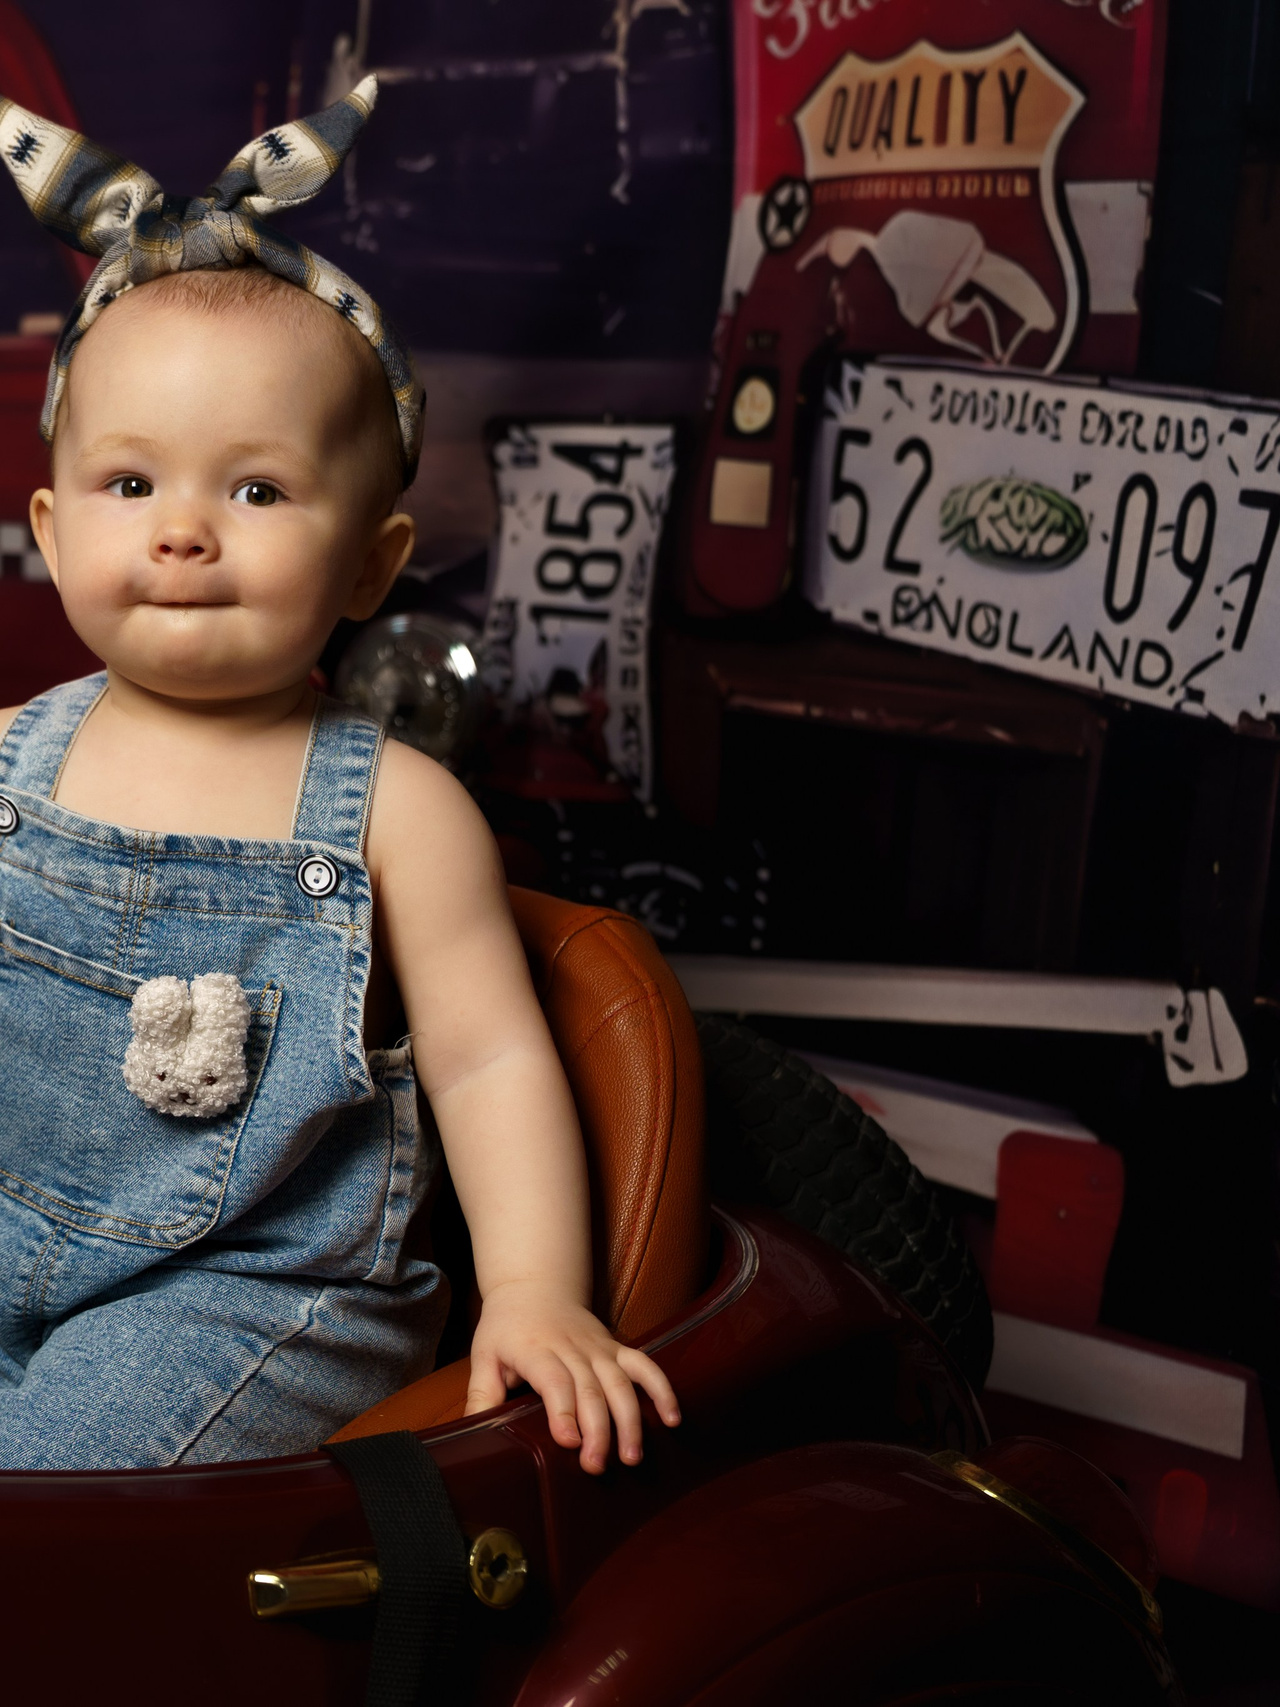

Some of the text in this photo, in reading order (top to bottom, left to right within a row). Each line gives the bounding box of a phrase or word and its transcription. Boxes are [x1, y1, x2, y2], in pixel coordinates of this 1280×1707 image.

[823, 68, 1027, 157] QUALITY
[529, 437, 644, 646] 1854
[828, 428, 1280, 652] 52 097
